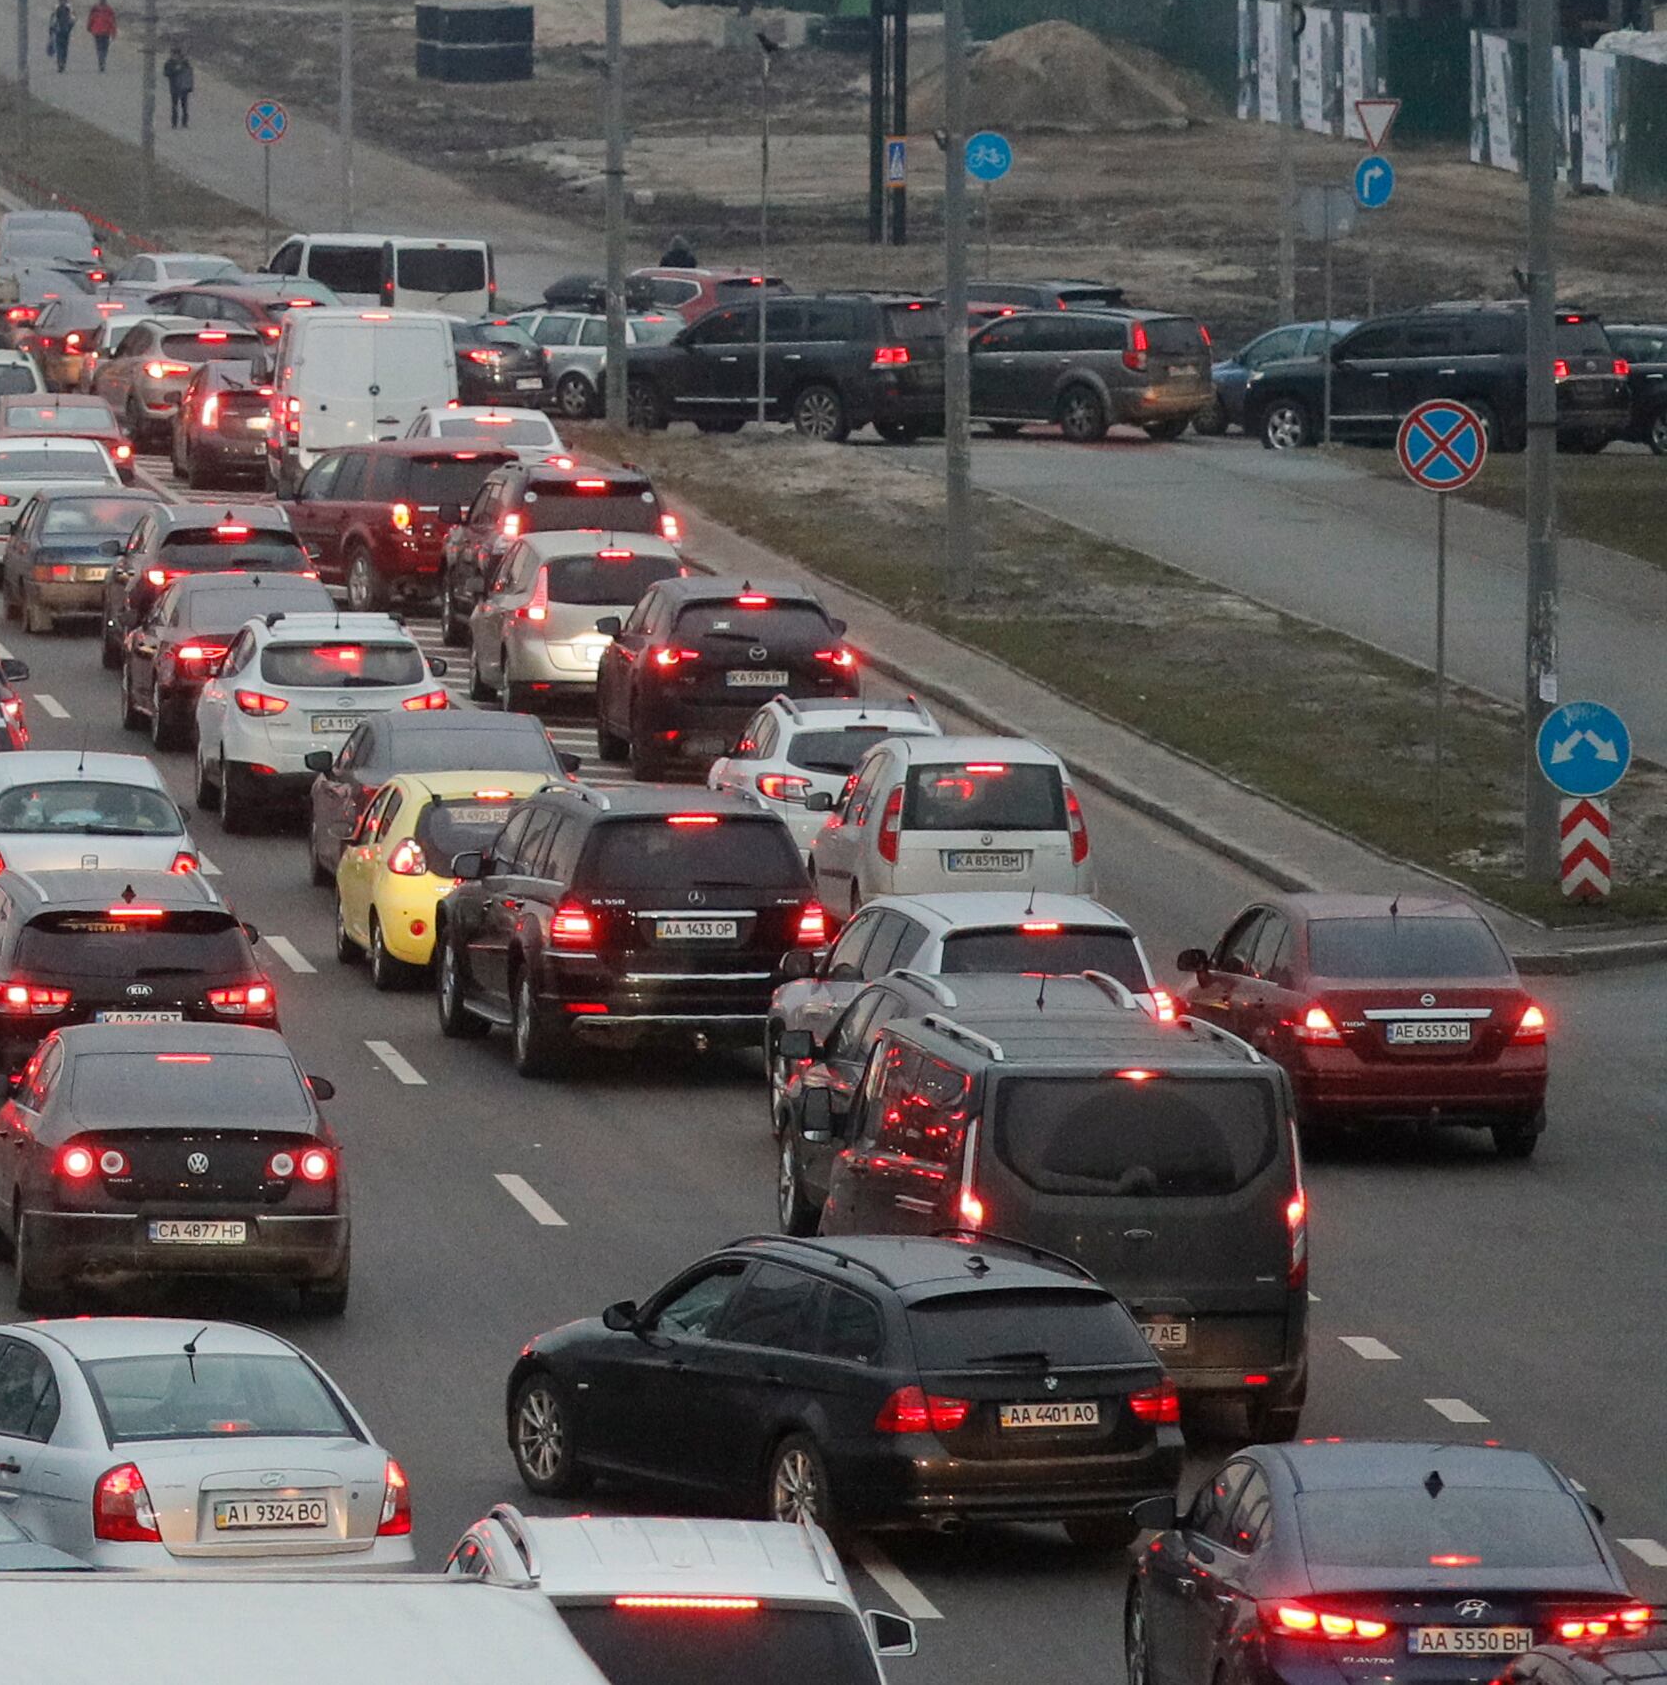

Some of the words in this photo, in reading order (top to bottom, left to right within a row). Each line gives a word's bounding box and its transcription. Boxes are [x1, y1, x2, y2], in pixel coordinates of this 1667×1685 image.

[319, 716, 334, 728] CA
[956, 855, 972, 866] KA
[976, 855, 1000, 866] 8511
[1002, 855, 1018, 866] BM
[664, 923, 684, 936] AA
[687, 923, 713, 936] 1433
[715, 923, 733, 936] OP
[131, 987, 149, 995] KIA
[102, 1013, 123, 1023] KA
[1396, 1026, 1413, 1038] AE
[1417, 1026, 1447, 1038] 6553
[1449, 1026, 1469, 1038] OH
[158, 1224, 182, 1239] CA
[184, 1224, 220, 1239] 4877
[222, 1224, 244, 1239] HP
[1159, 1326, 1181, 1341] AE
[1010, 1408, 1031, 1424] AA
[1036, 1407, 1071, 1423] 4401
[1074, 1405, 1095, 1421] AO
[228, 1506, 250, 1524] AI
[256, 1505, 297, 1522] 9324
[300, 1504, 323, 1521] BO
[1418, 1629, 1448, 1653] AA
[1453, 1629, 1498, 1652] 5550
[1502, 1629, 1531, 1652] BH
[1342, 1656, 1395, 1664] ELANTRA
